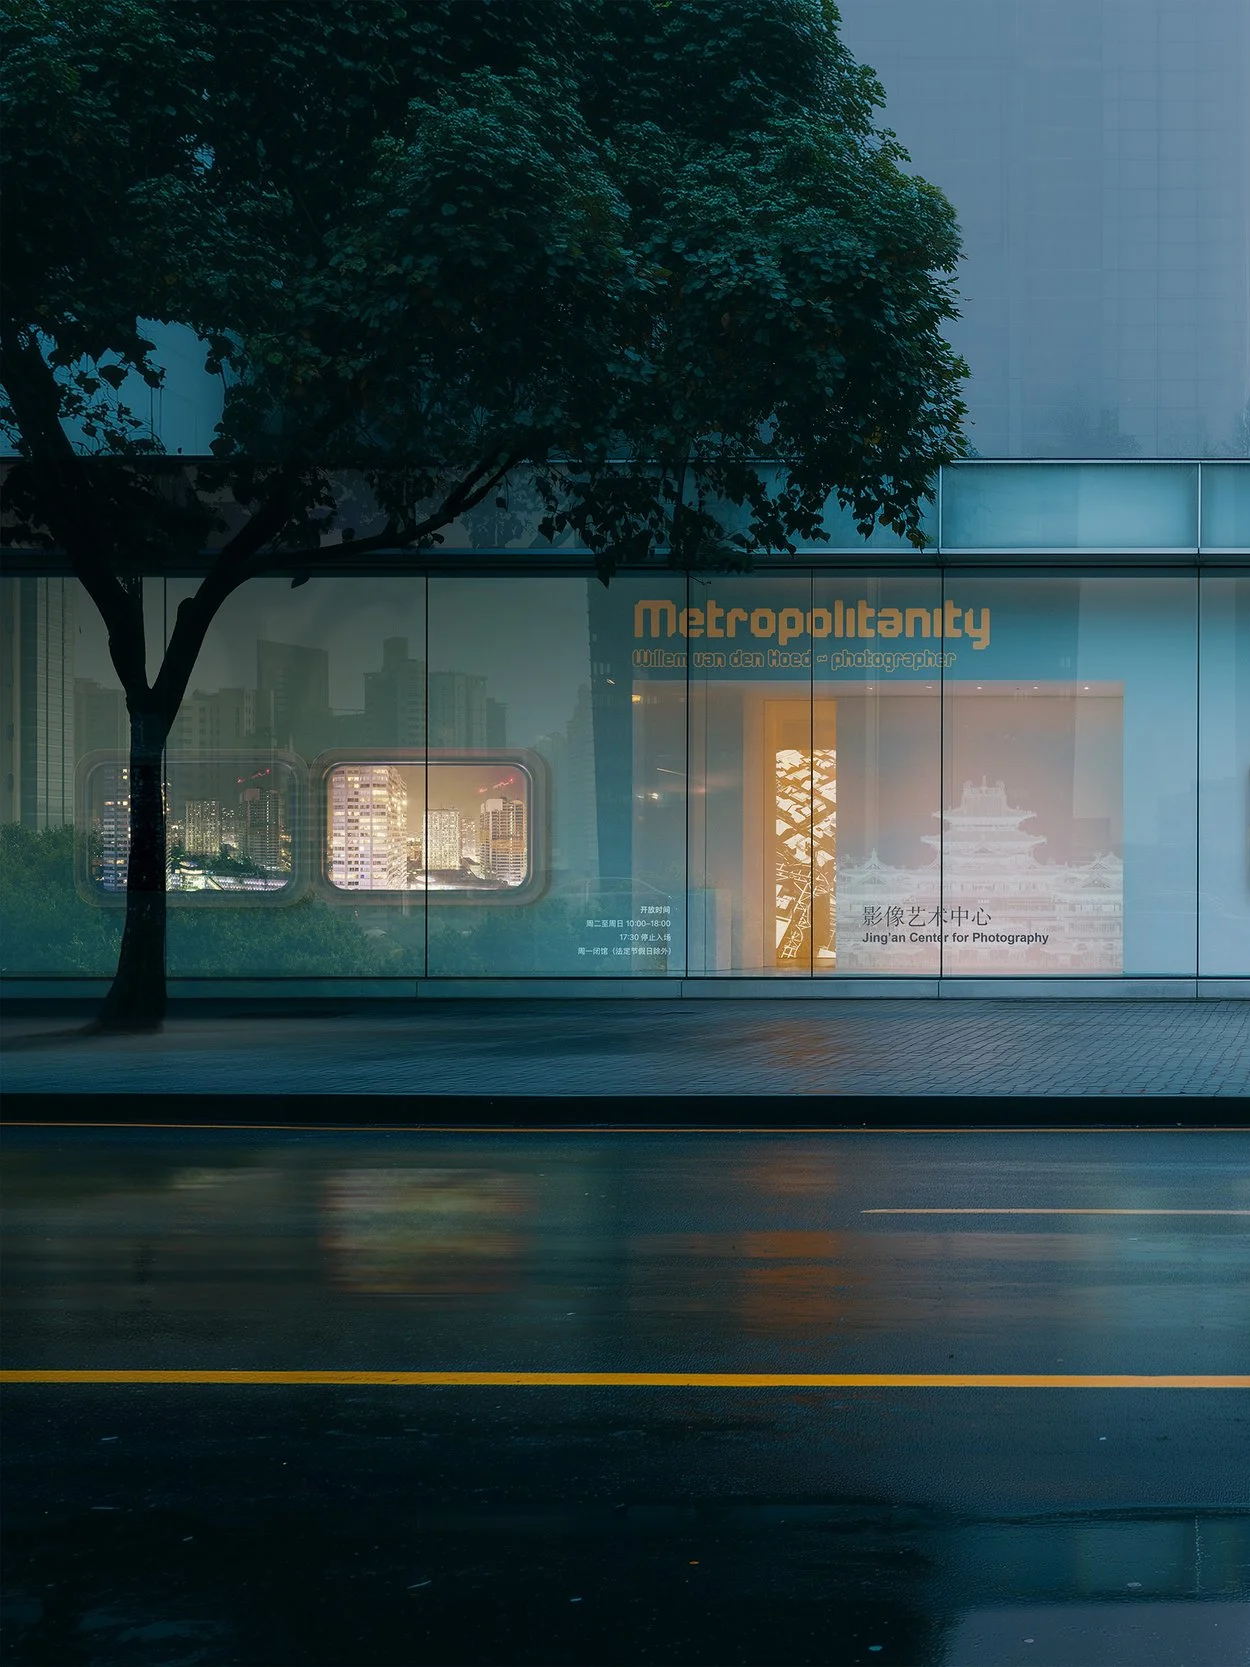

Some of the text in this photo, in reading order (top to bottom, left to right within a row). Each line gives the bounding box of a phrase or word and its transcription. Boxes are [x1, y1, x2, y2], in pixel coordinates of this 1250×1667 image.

[634, 600, 990, 649] Metropolitanity
[632, 649, 687, 668] Willem
[692, 652, 726, 668] van
[729, 650, 764, 668] den
[767, 649, 812, 668] Hoed
[831, 649, 957, 672] photographer
[640, 906, 671, 914] 开放时间
[862, 905, 992, 928] 影像艺术中心
[586, 920, 624, 928] 周二至周日
[641, 933, 672, 942] 停止入场
[909, 932, 949, 943] Center
[952, 932, 969, 943] for
[972, 932, 1049, 945] Photography
